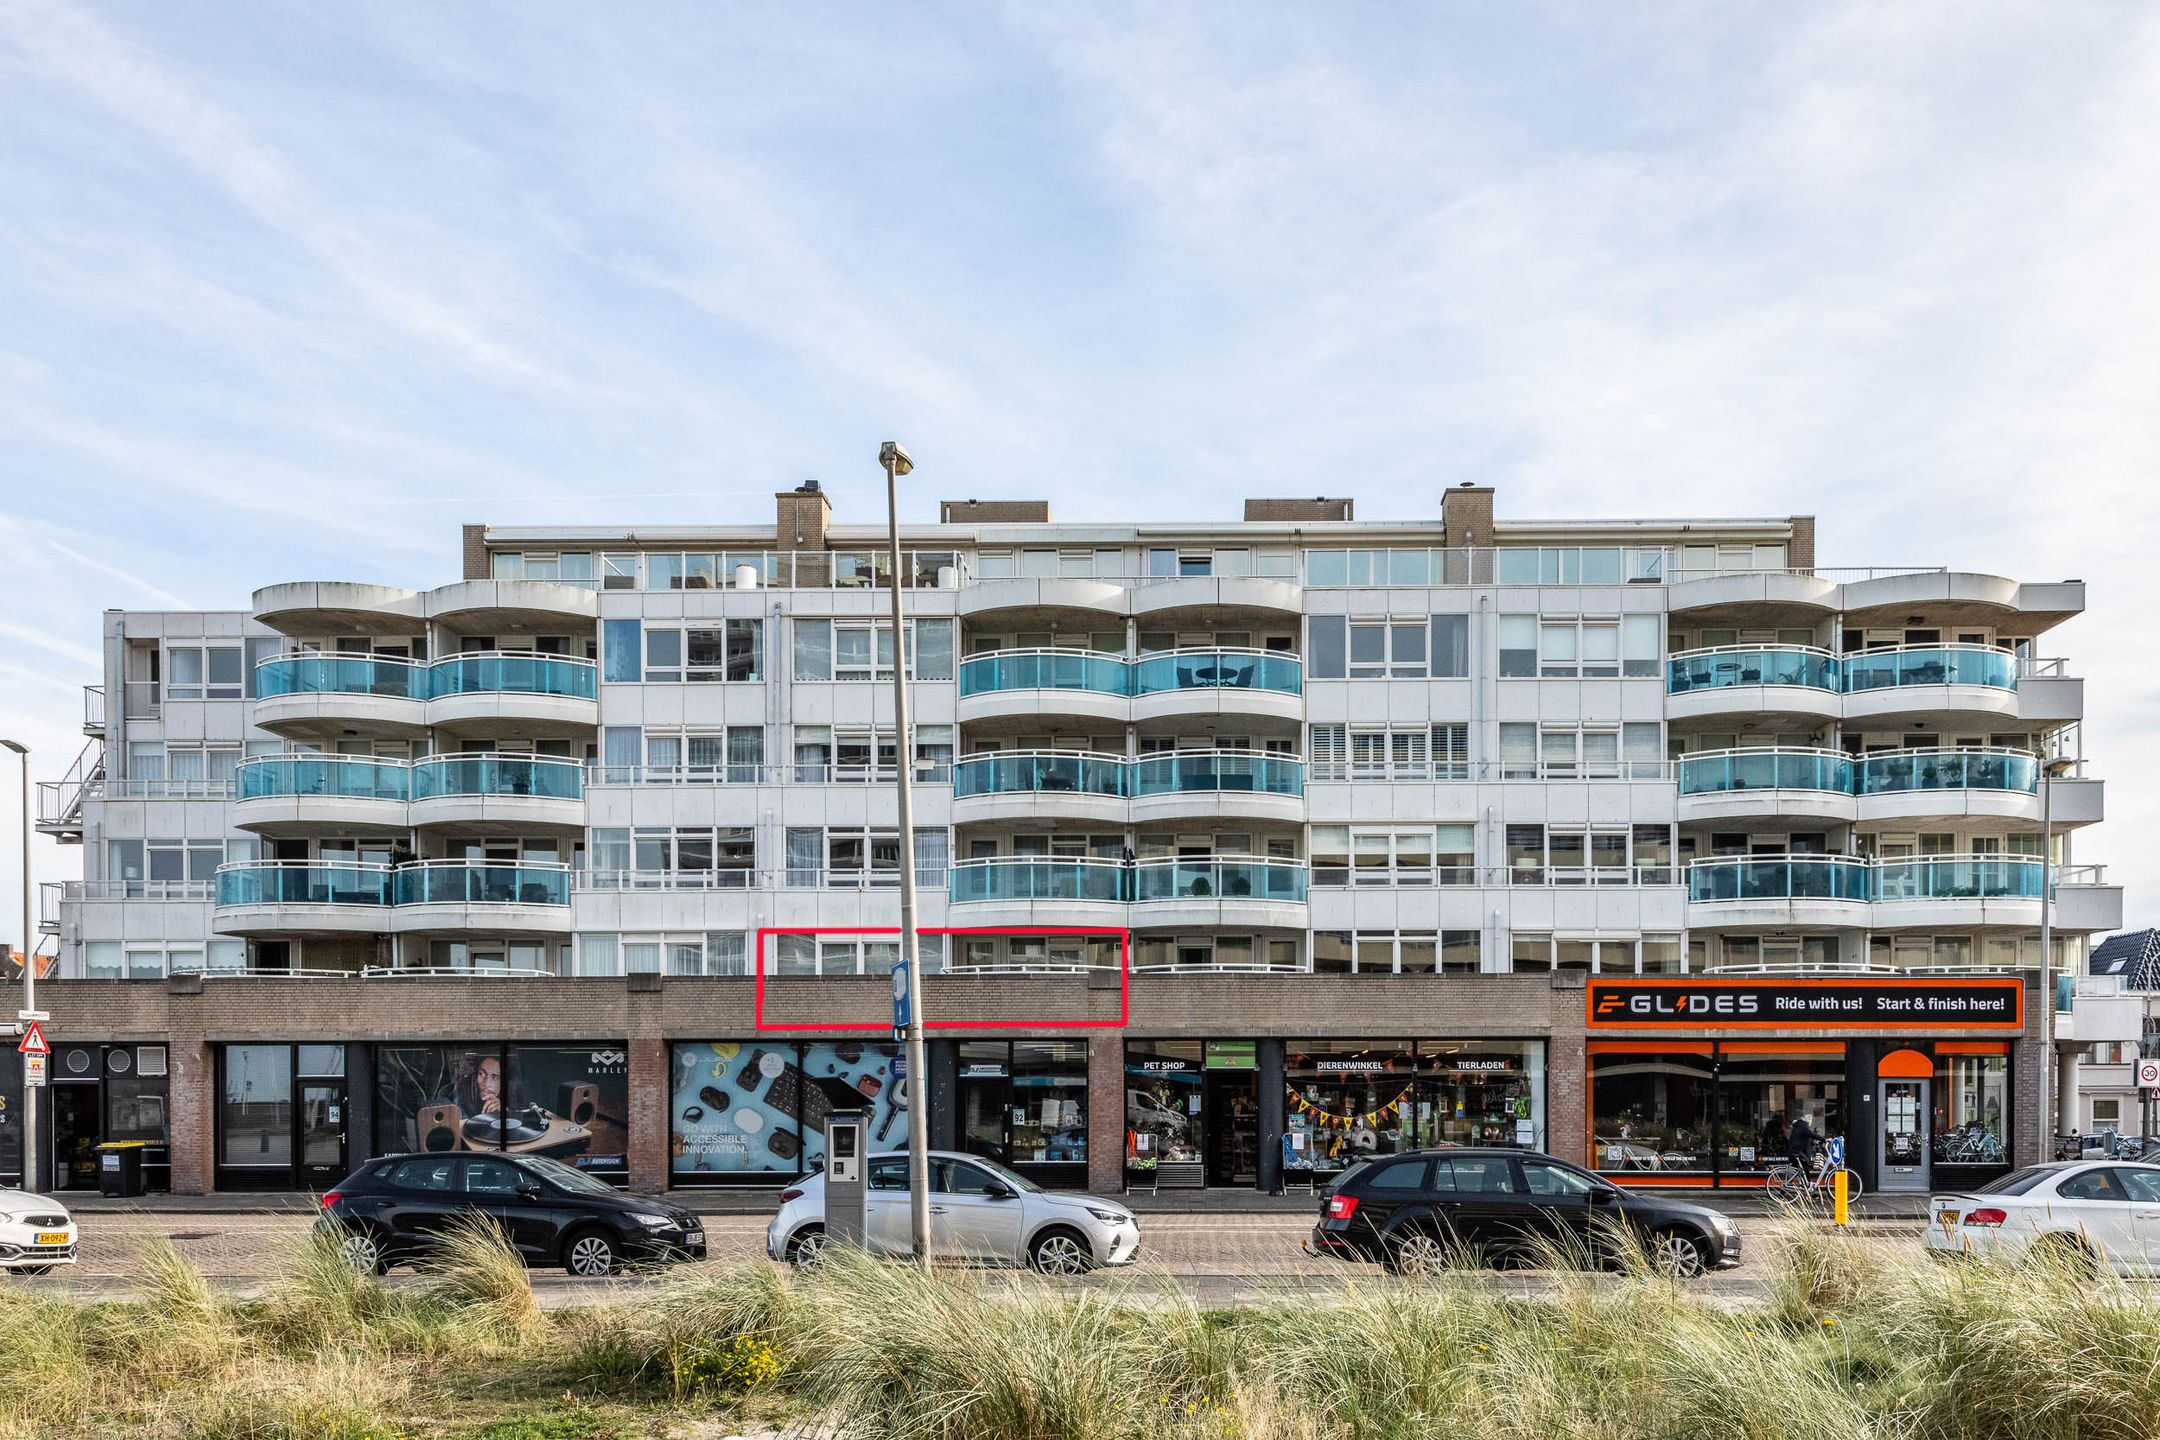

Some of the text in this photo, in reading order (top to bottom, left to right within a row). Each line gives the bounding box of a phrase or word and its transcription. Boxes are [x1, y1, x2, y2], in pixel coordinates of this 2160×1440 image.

[1775, 996, 1863, 1010] Ride with us!
[1877, 996, 2005, 1010] Start & finish here!
[1143, 1061, 1186, 1070] PET SHOP
[1317, 1061, 1383, 1070] DIERENWINKEL
[1457, 1061, 1505, 1070] TIERLADEN
[2144, 1069, 2156, 1077] 30
[330, 1111, 339, 1119] 94
[1014, 1113, 1024, 1122] 92
[682, 1124, 728, 1133] GO WITH
[682, 1134, 748, 1144] ACCESSIBLE
